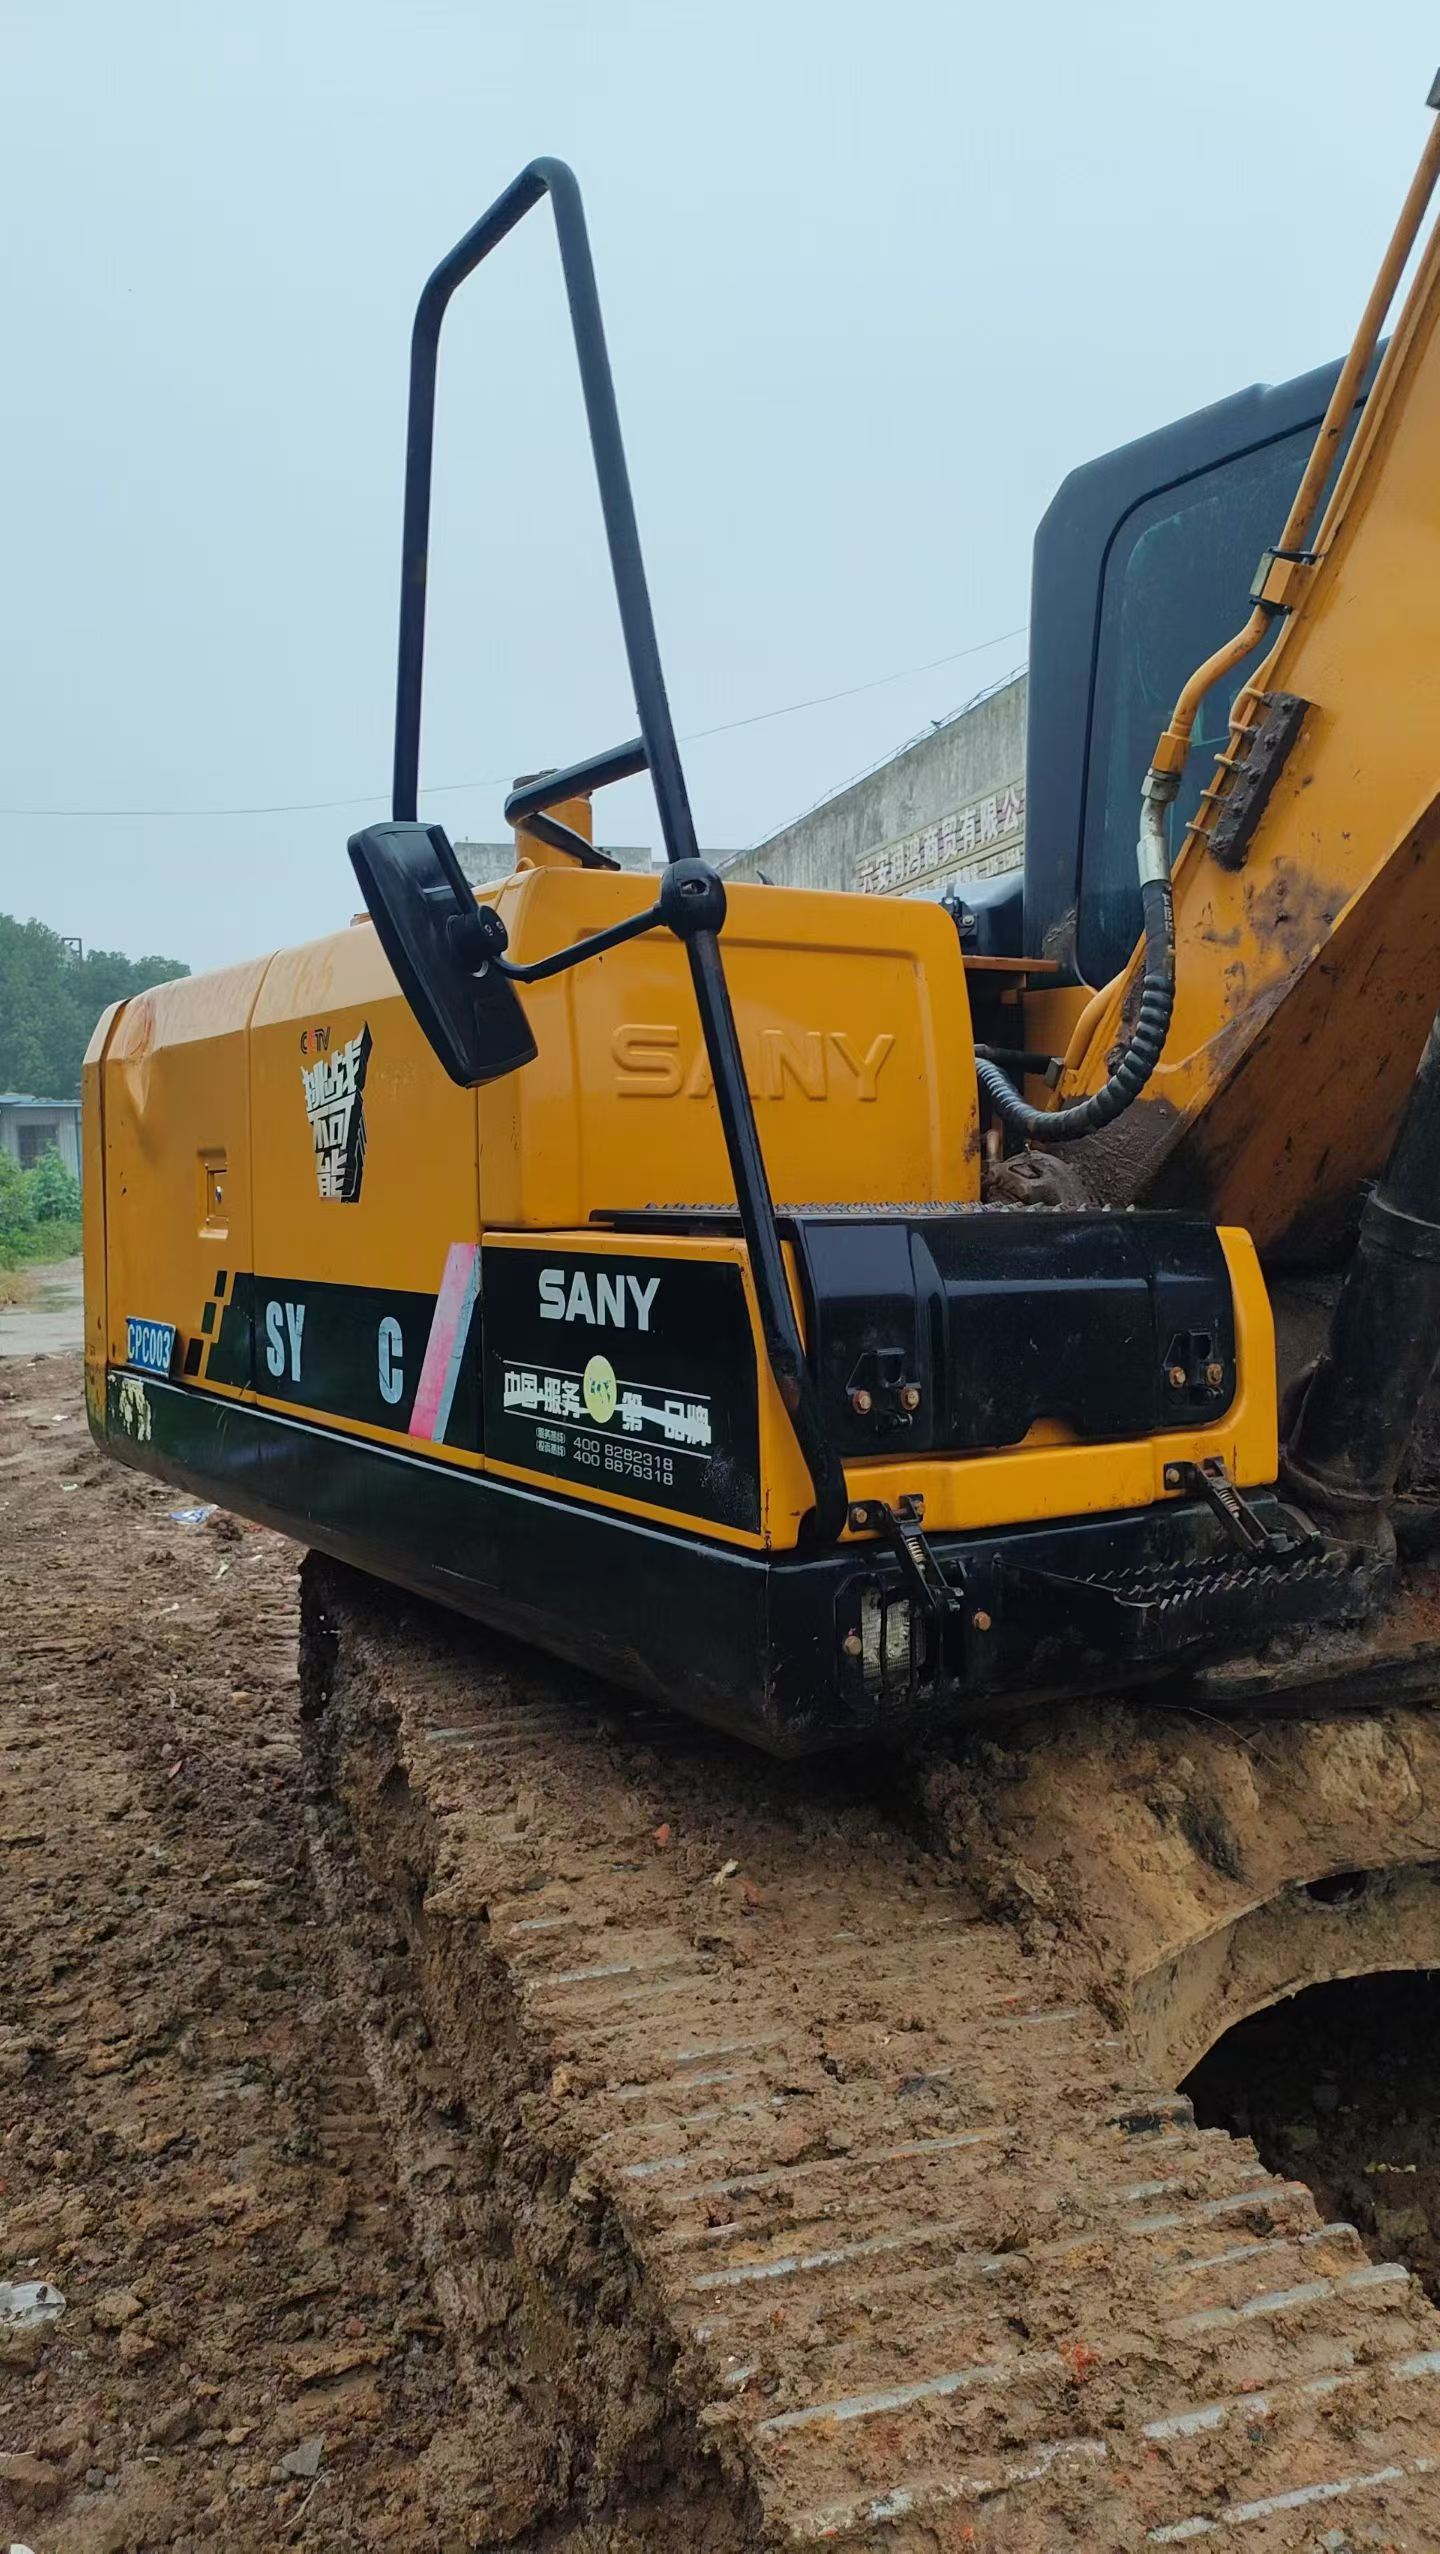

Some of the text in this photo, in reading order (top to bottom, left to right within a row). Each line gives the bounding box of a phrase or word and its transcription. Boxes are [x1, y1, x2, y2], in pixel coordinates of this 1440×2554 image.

[300, 1026, 331, 1055] CCTV
[538, 1268, 661, 1331] SANY
[128, 1323, 171, 1369] CPC003
[266, 1301, 403, 1404] SY C
[573, 1437, 600, 1453] 400
[604, 1443, 673, 1471] 8282318
[573, 1450, 673, 1485] 400 8879318
